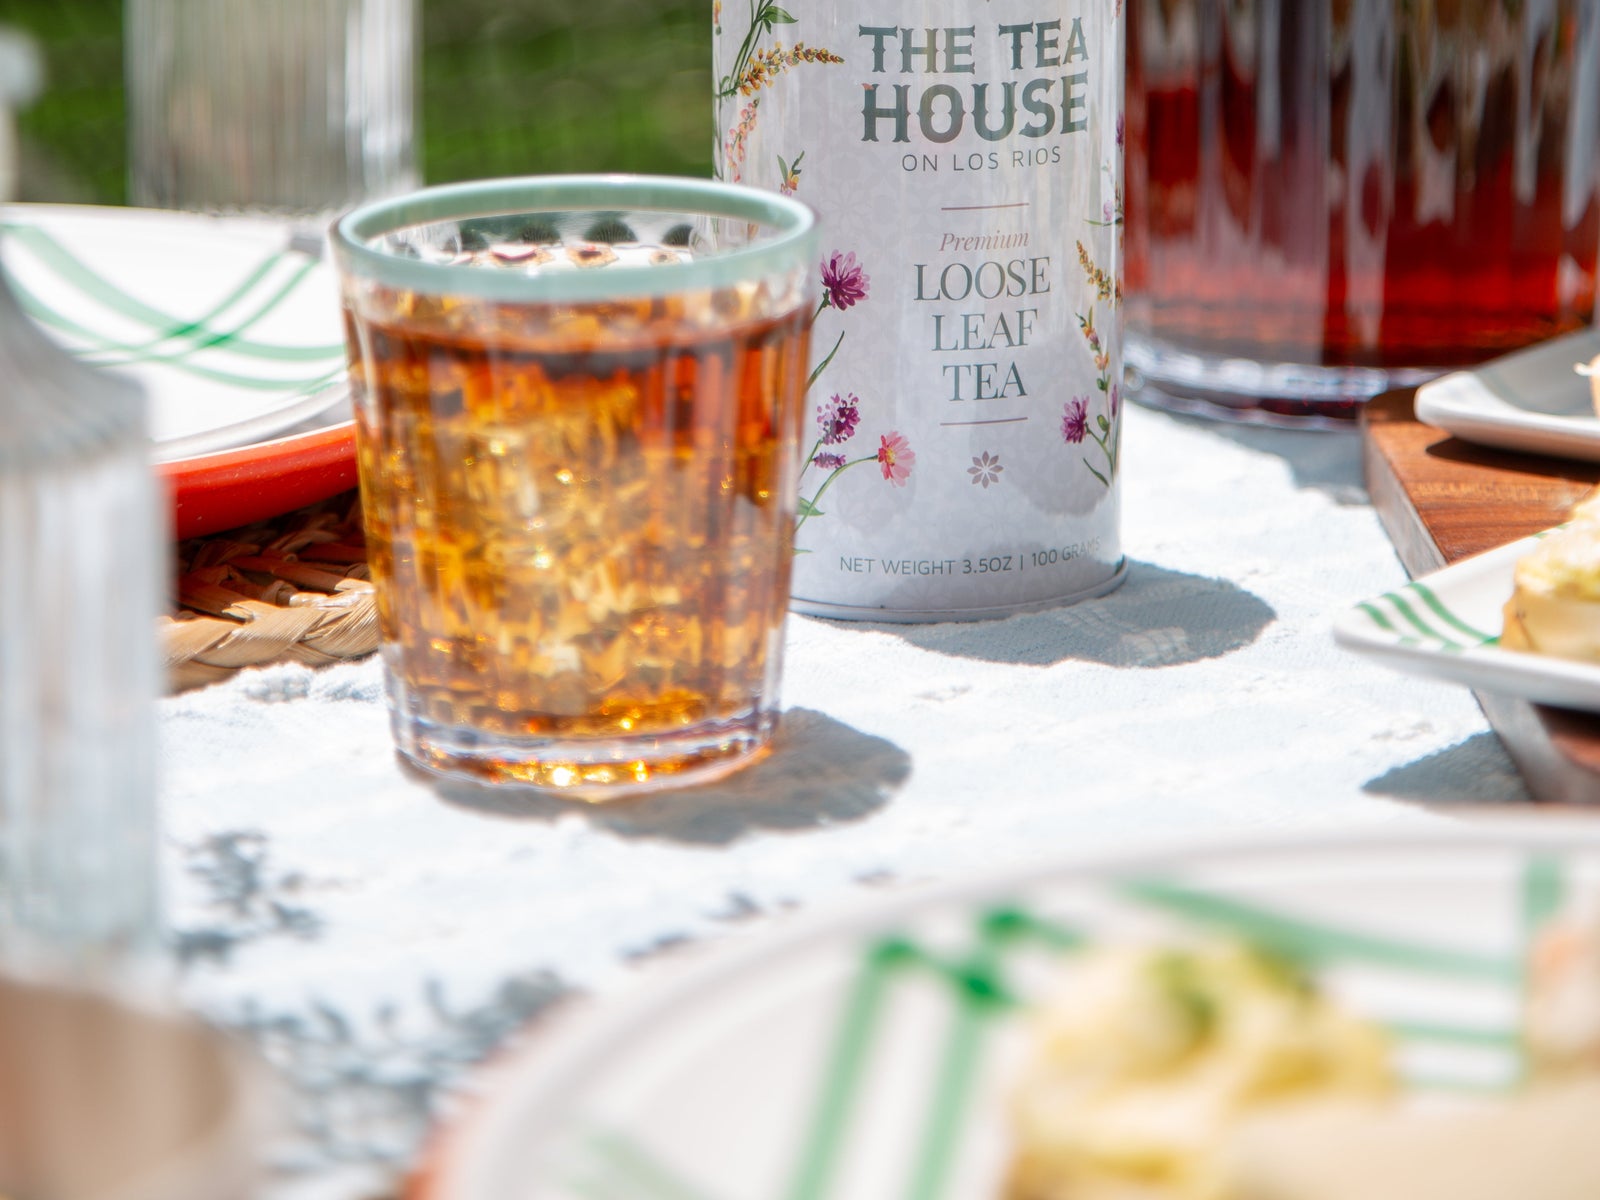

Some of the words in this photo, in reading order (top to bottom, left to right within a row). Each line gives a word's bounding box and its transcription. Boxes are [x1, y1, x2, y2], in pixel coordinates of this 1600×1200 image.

[858, 24, 976, 75] THE
[998, 16, 1090, 71] TEA
[861, 69, 1089, 144] HOUSE
[902, 154, 939, 172] ON
[953, 152, 999, 172] LOS
[1012, 145, 1061, 168] RIOS
[938, 230, 1030, 251] Premium
[913, 256, 1051, 301] LOOSE
[931, 308, 1038, 352] LEAF
[942, 361, 1028, 402] TEA
[839, 556, 875, 573] NET
[880, 558, 956, 575] WEIGHT
[1031, 548, 1057, 567] 100
[1061, 537, 1101, 562] GRAMS
